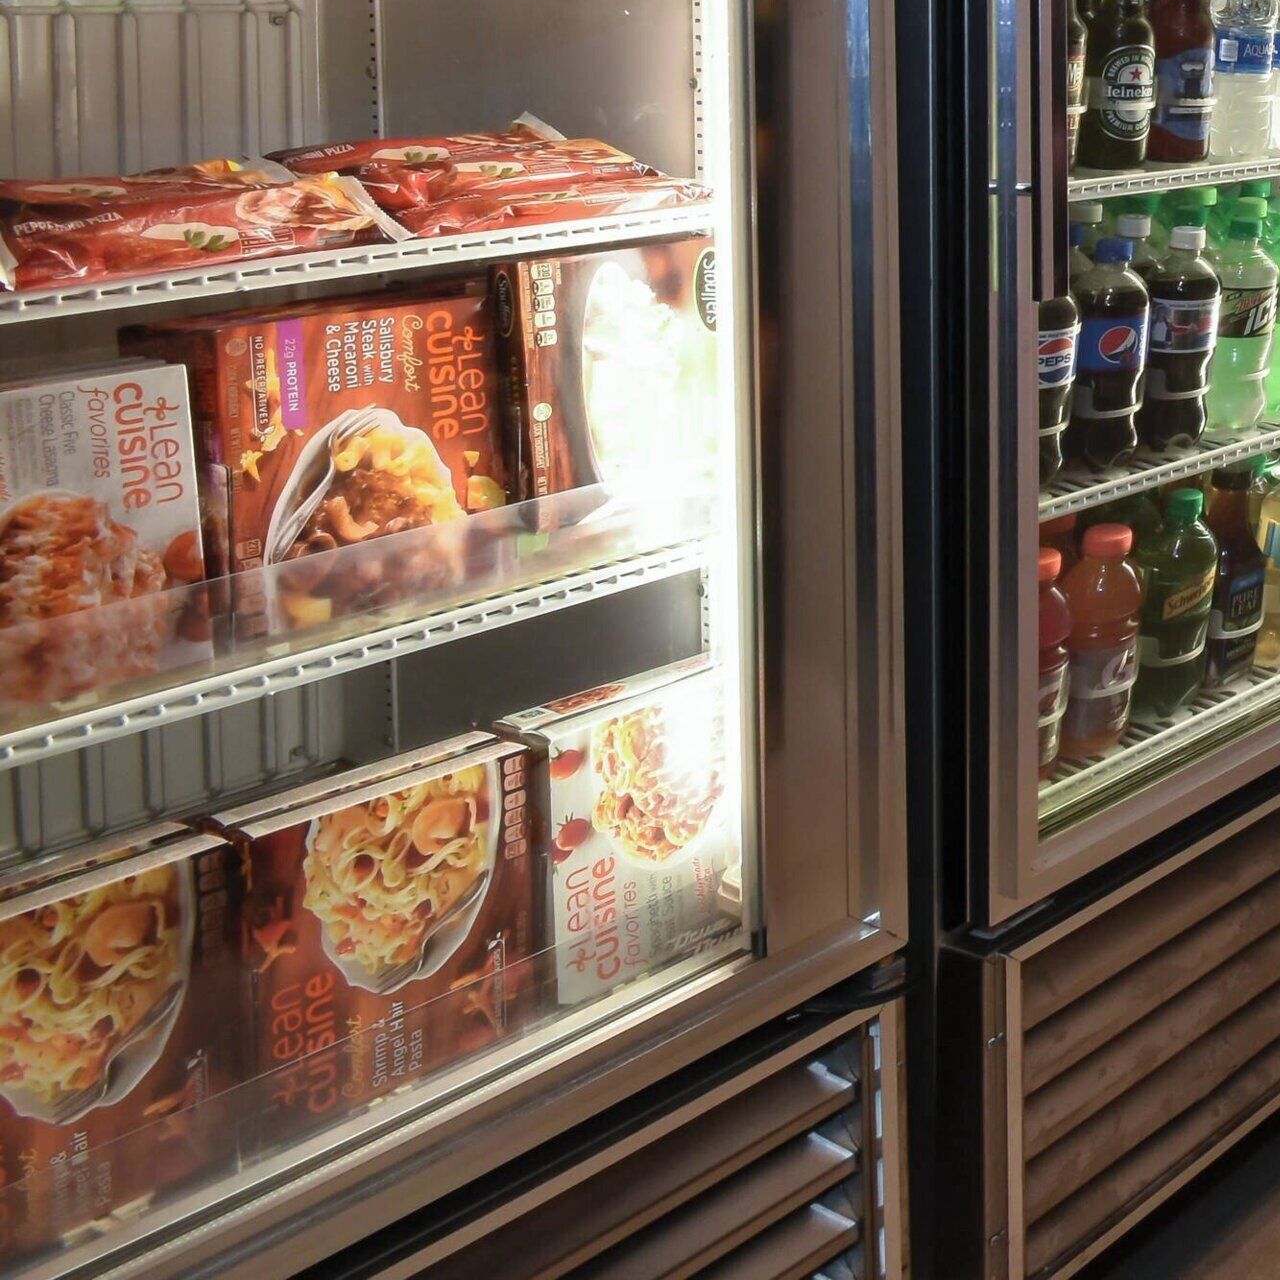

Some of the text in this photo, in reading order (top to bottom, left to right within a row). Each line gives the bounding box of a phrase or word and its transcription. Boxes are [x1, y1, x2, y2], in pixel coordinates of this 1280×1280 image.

[324, 142, 355, 157] PIZZA
[326, 324, 341, 393] & Cheese
[344, 321, 361, 389] Macaroni
[361, 319, 377, 386] Steak with
[378, 316, 395, 384] Salisbury
[399, 314, 424, 393] Comfort
[255, 347, 270, 425] PRESERVATIVES
[286, 361, 299, 412] PROTEIN
[456, 352, 489, 436] Lean
[39, 393, 60, 488] Cheese Lasagna
[58, 390, 79, 456] Classic Five
[77, 385, 111, 479] favorites
[149, 422, 184, 504] Lean
[372, 1031, 391, 1088] Shrimp
[388, 1000, 408, 1077] Angel Hair
[408, 1027, 424, 1072] Pasta
